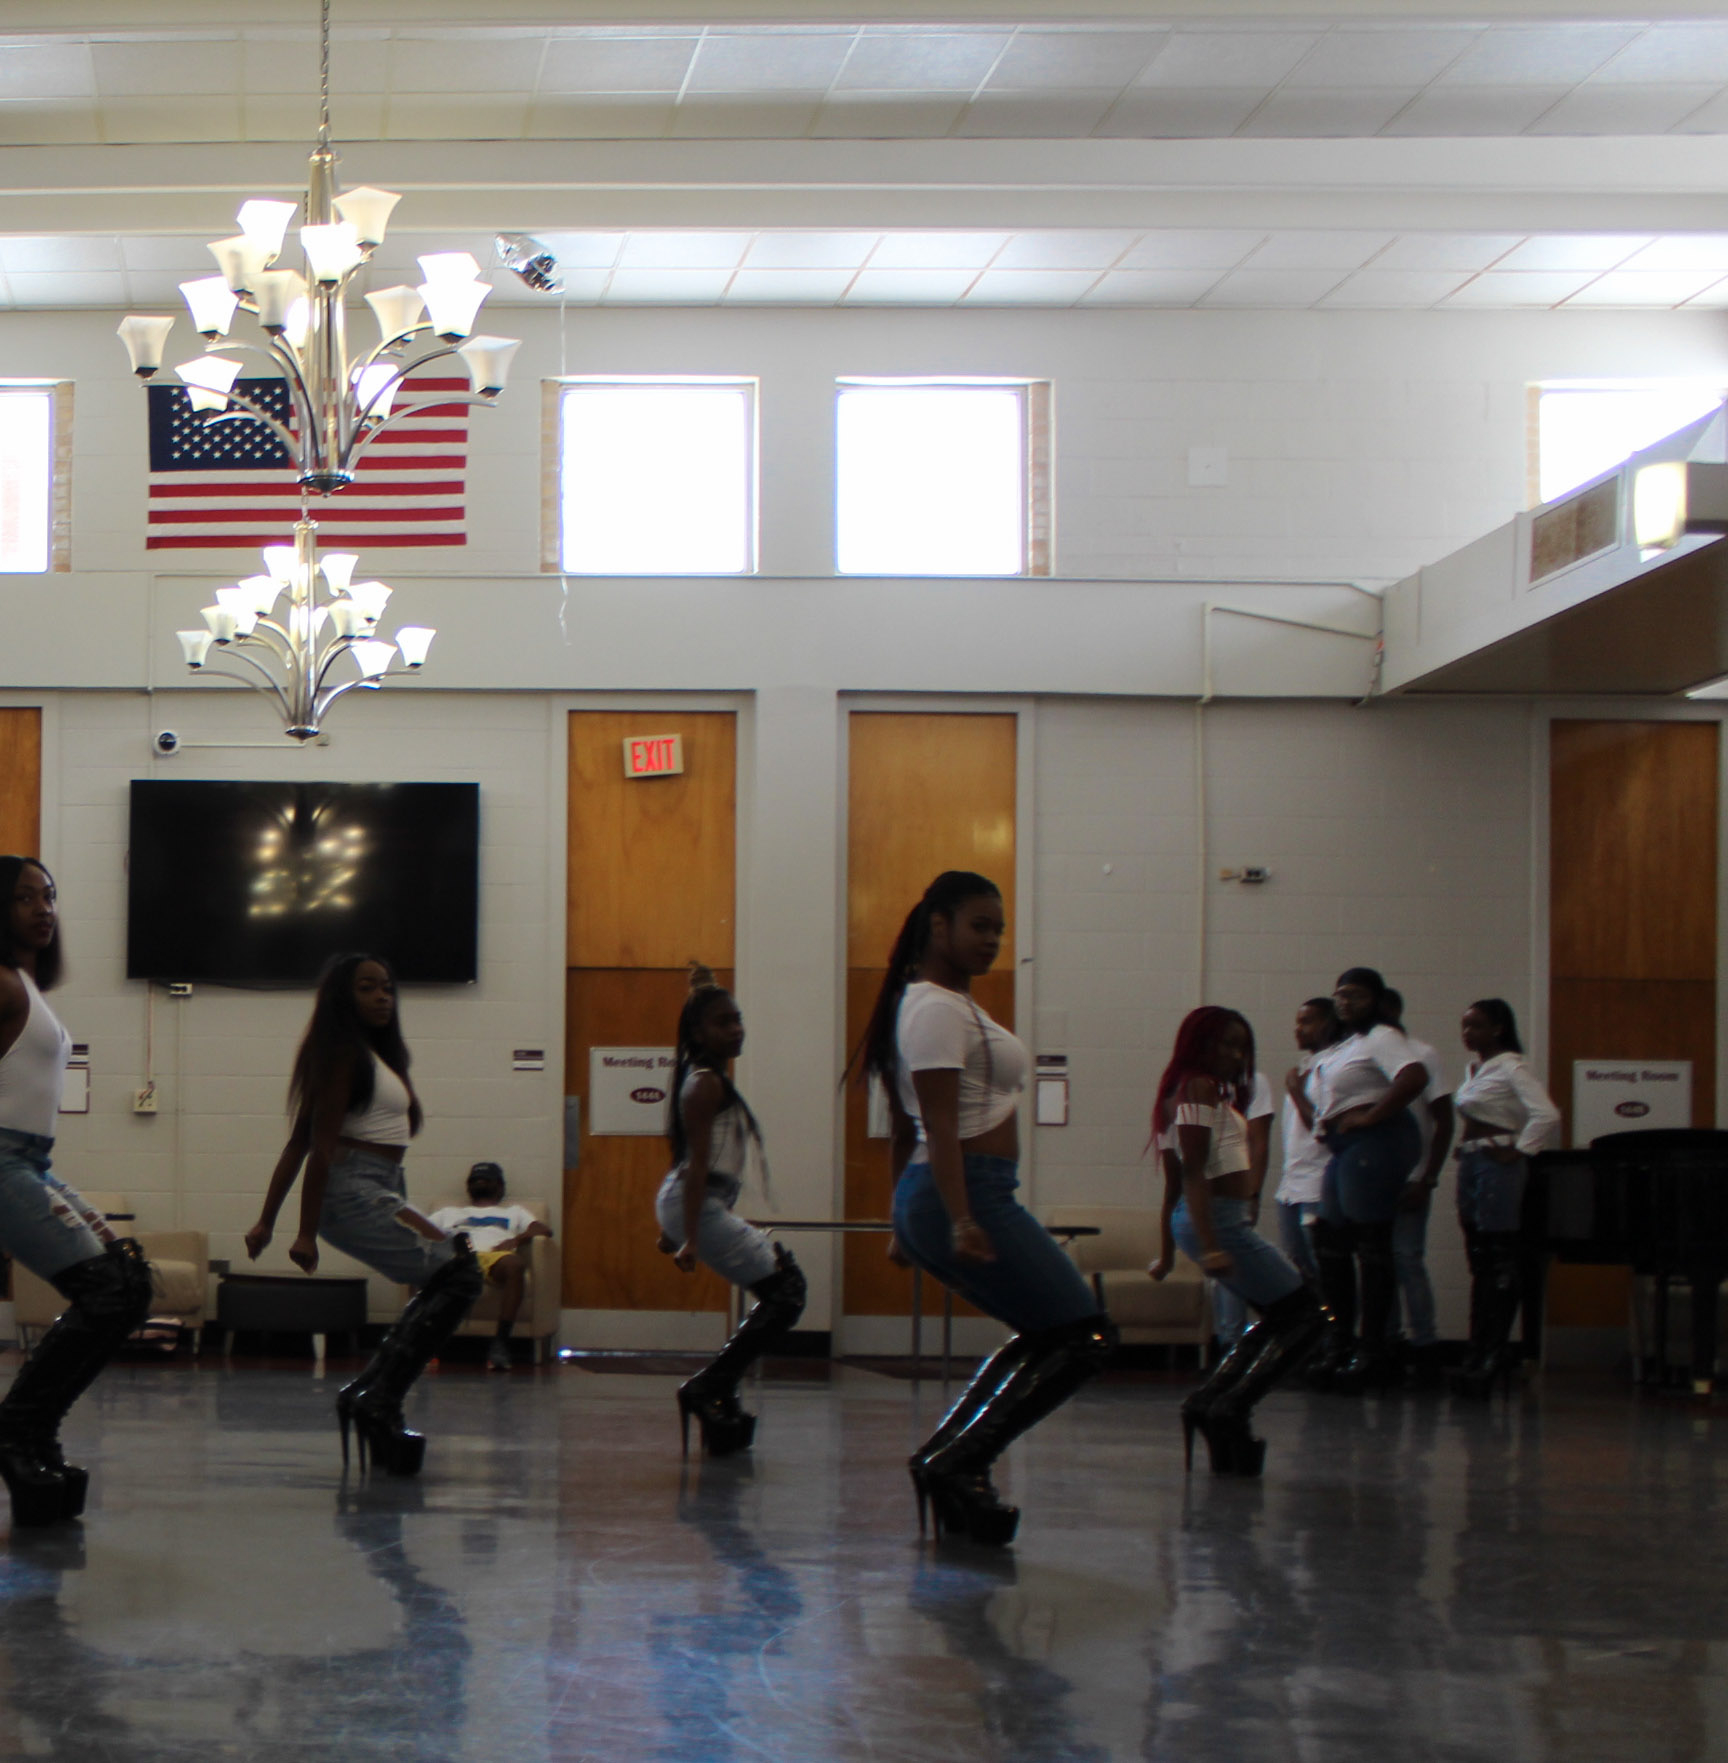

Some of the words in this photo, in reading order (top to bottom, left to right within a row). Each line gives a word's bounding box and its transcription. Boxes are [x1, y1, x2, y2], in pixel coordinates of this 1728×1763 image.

[631, 739, 676, 772] EXIT
[602, 1056, 654, 1070] Meeting
[1586, 1070, 1637, 1084] Meeting
[1641, 1070, 1679, 1081] Room
